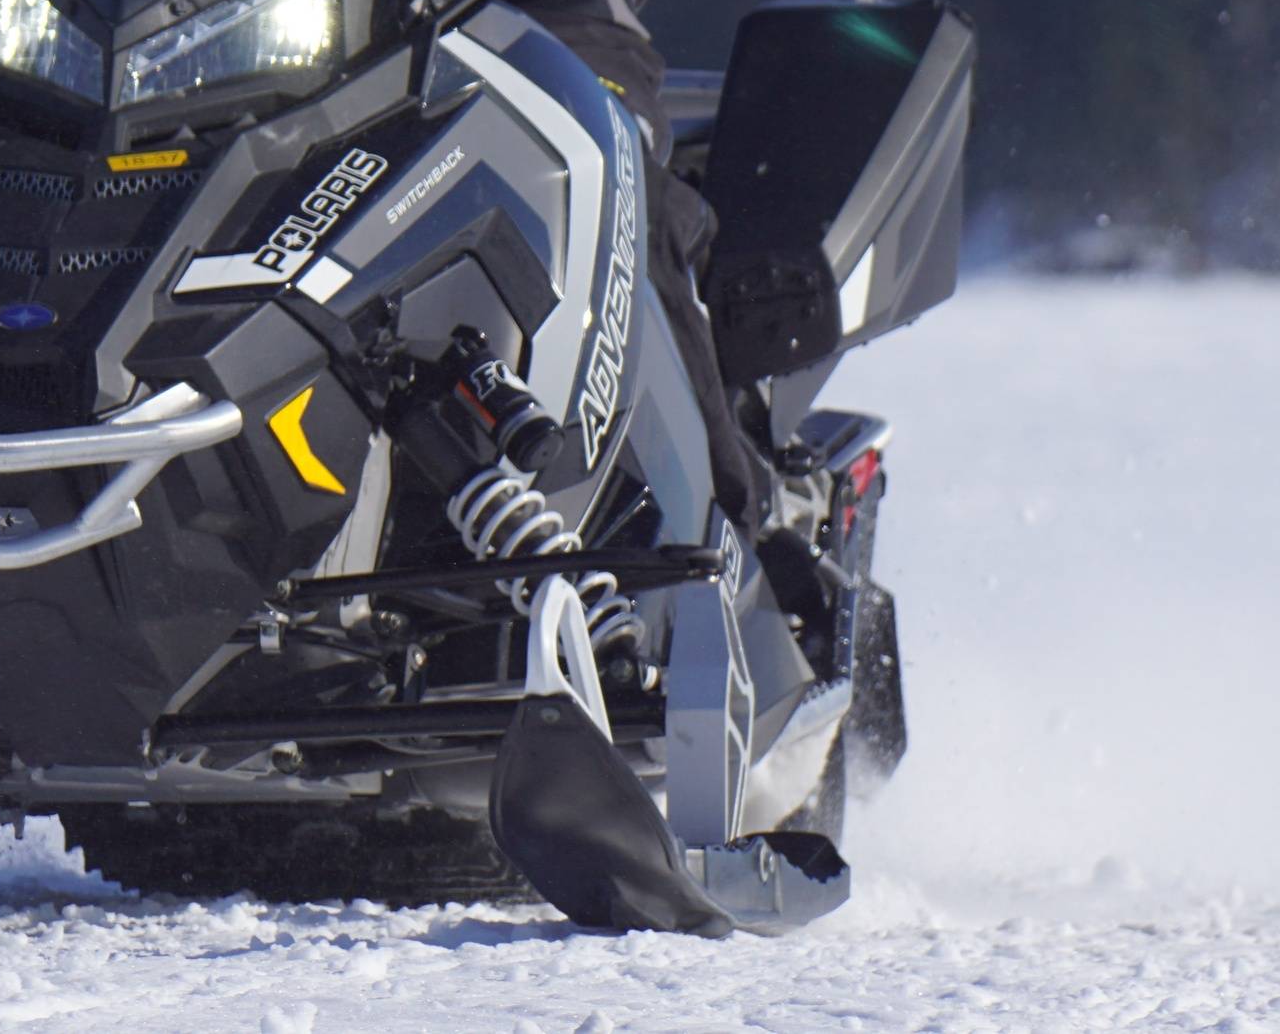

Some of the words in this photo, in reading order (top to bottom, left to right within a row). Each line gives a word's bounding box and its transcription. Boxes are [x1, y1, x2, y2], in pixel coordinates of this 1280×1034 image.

[252, 147, 388, 273] POLARIS
[385, 145, 465, 225] SWITCHBACK
[578, 97, 637, 469] ADVENTURE
